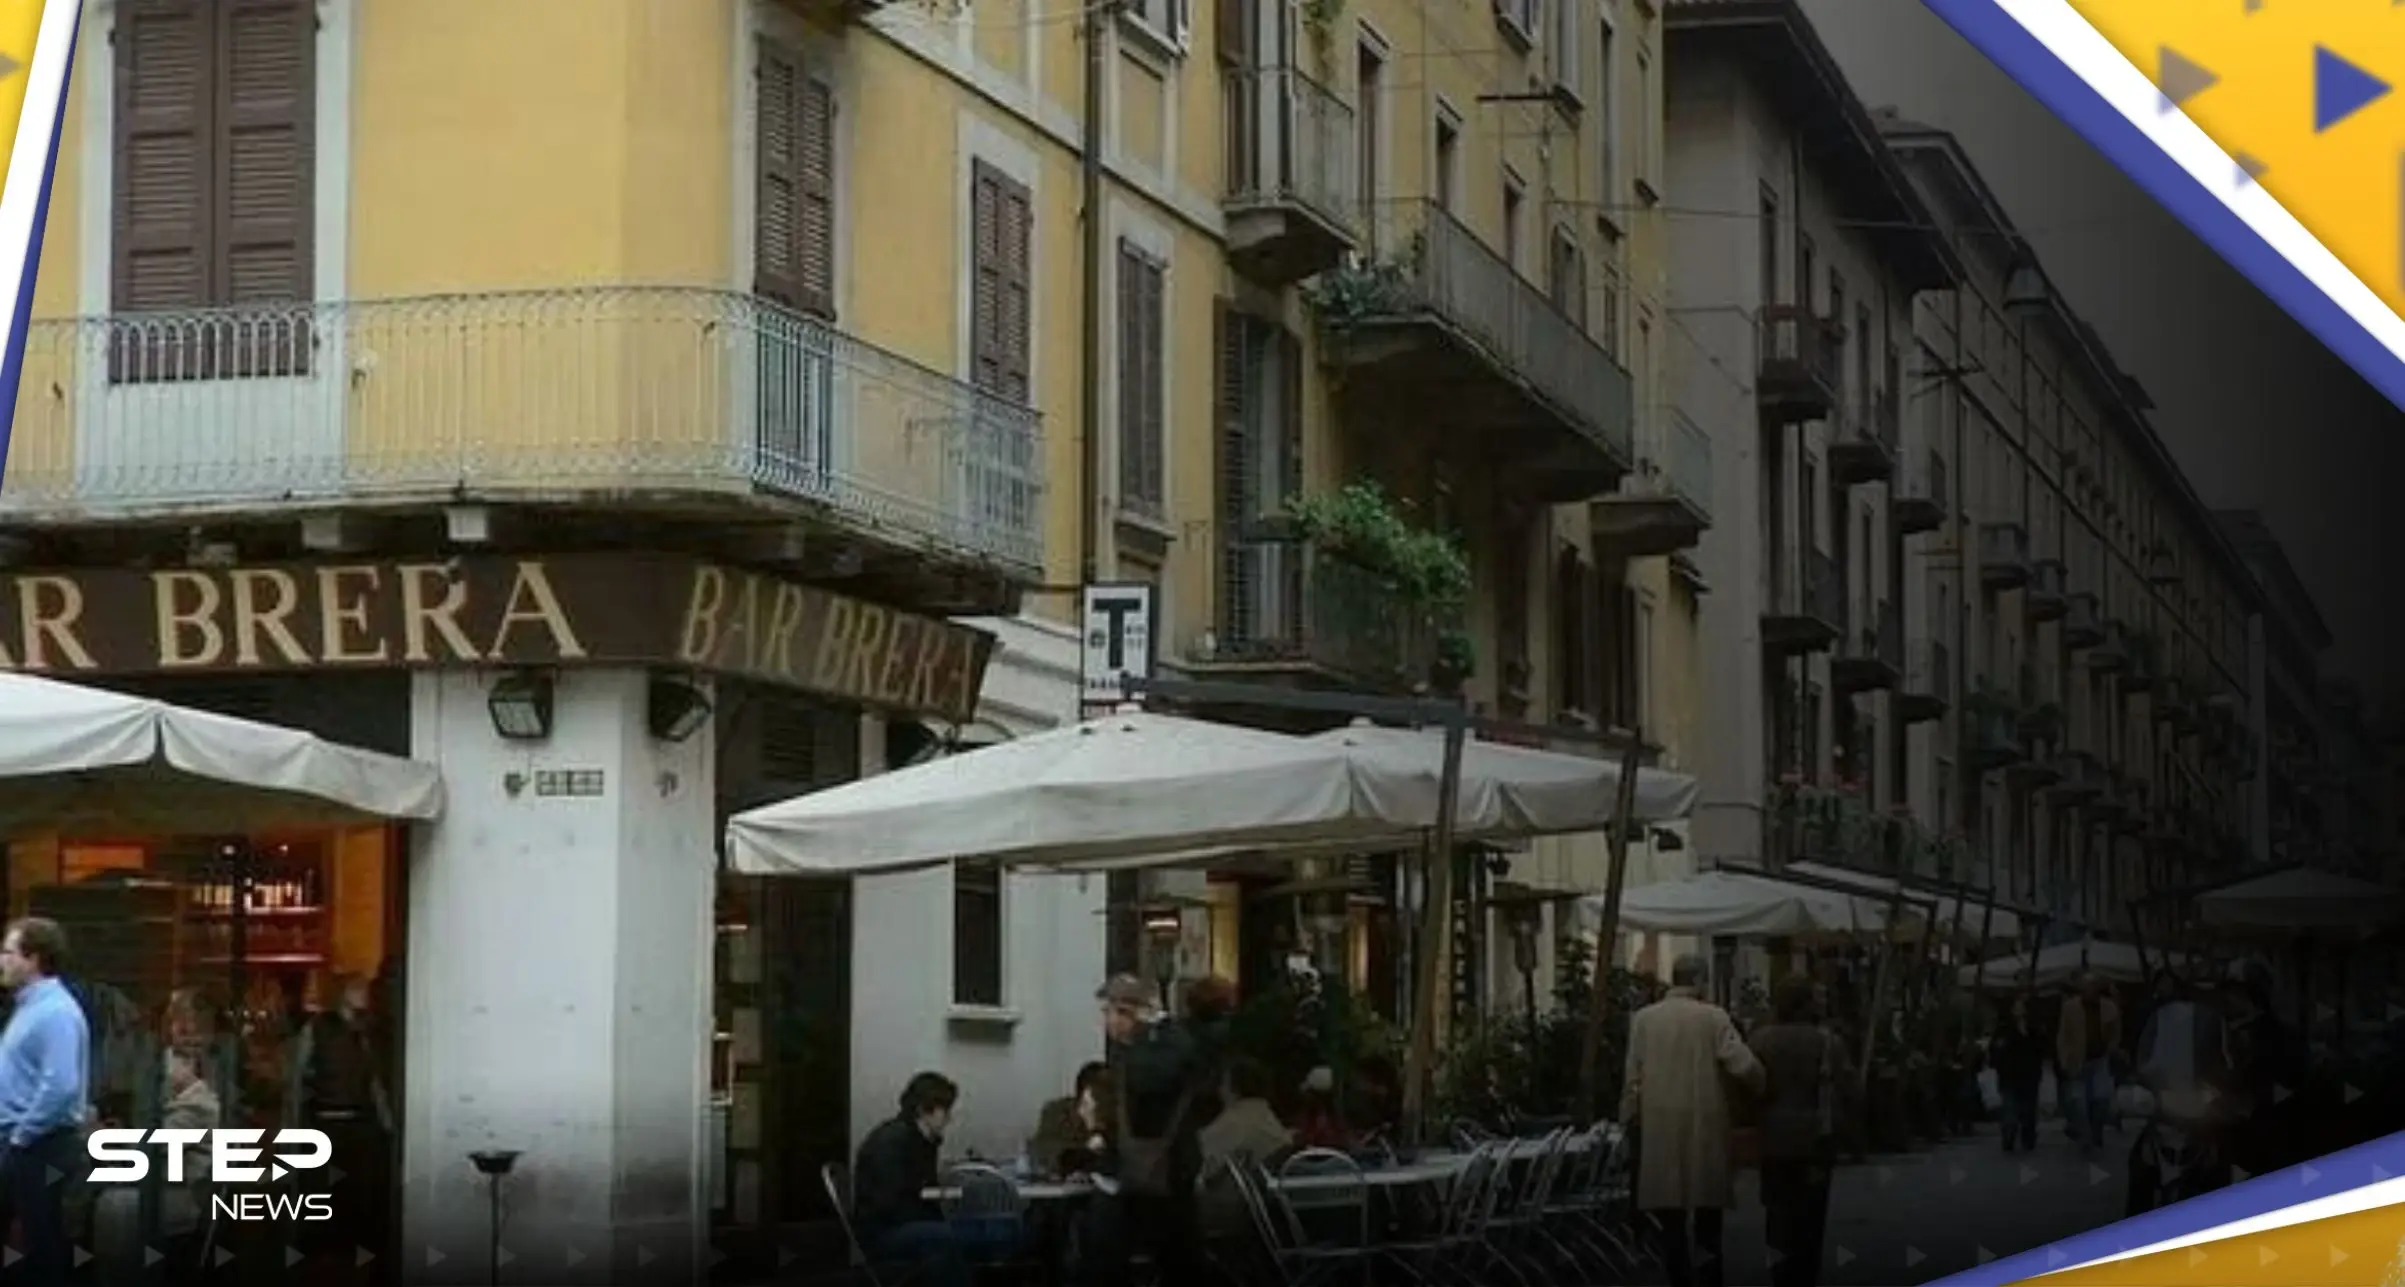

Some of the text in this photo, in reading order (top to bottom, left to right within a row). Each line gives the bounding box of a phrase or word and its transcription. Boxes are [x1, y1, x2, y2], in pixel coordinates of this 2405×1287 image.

[0, 562, 588, 668] R BRERA
[680, 564, 977, 717] BAR BRERA
[1091, 598, 1142, 668] T
